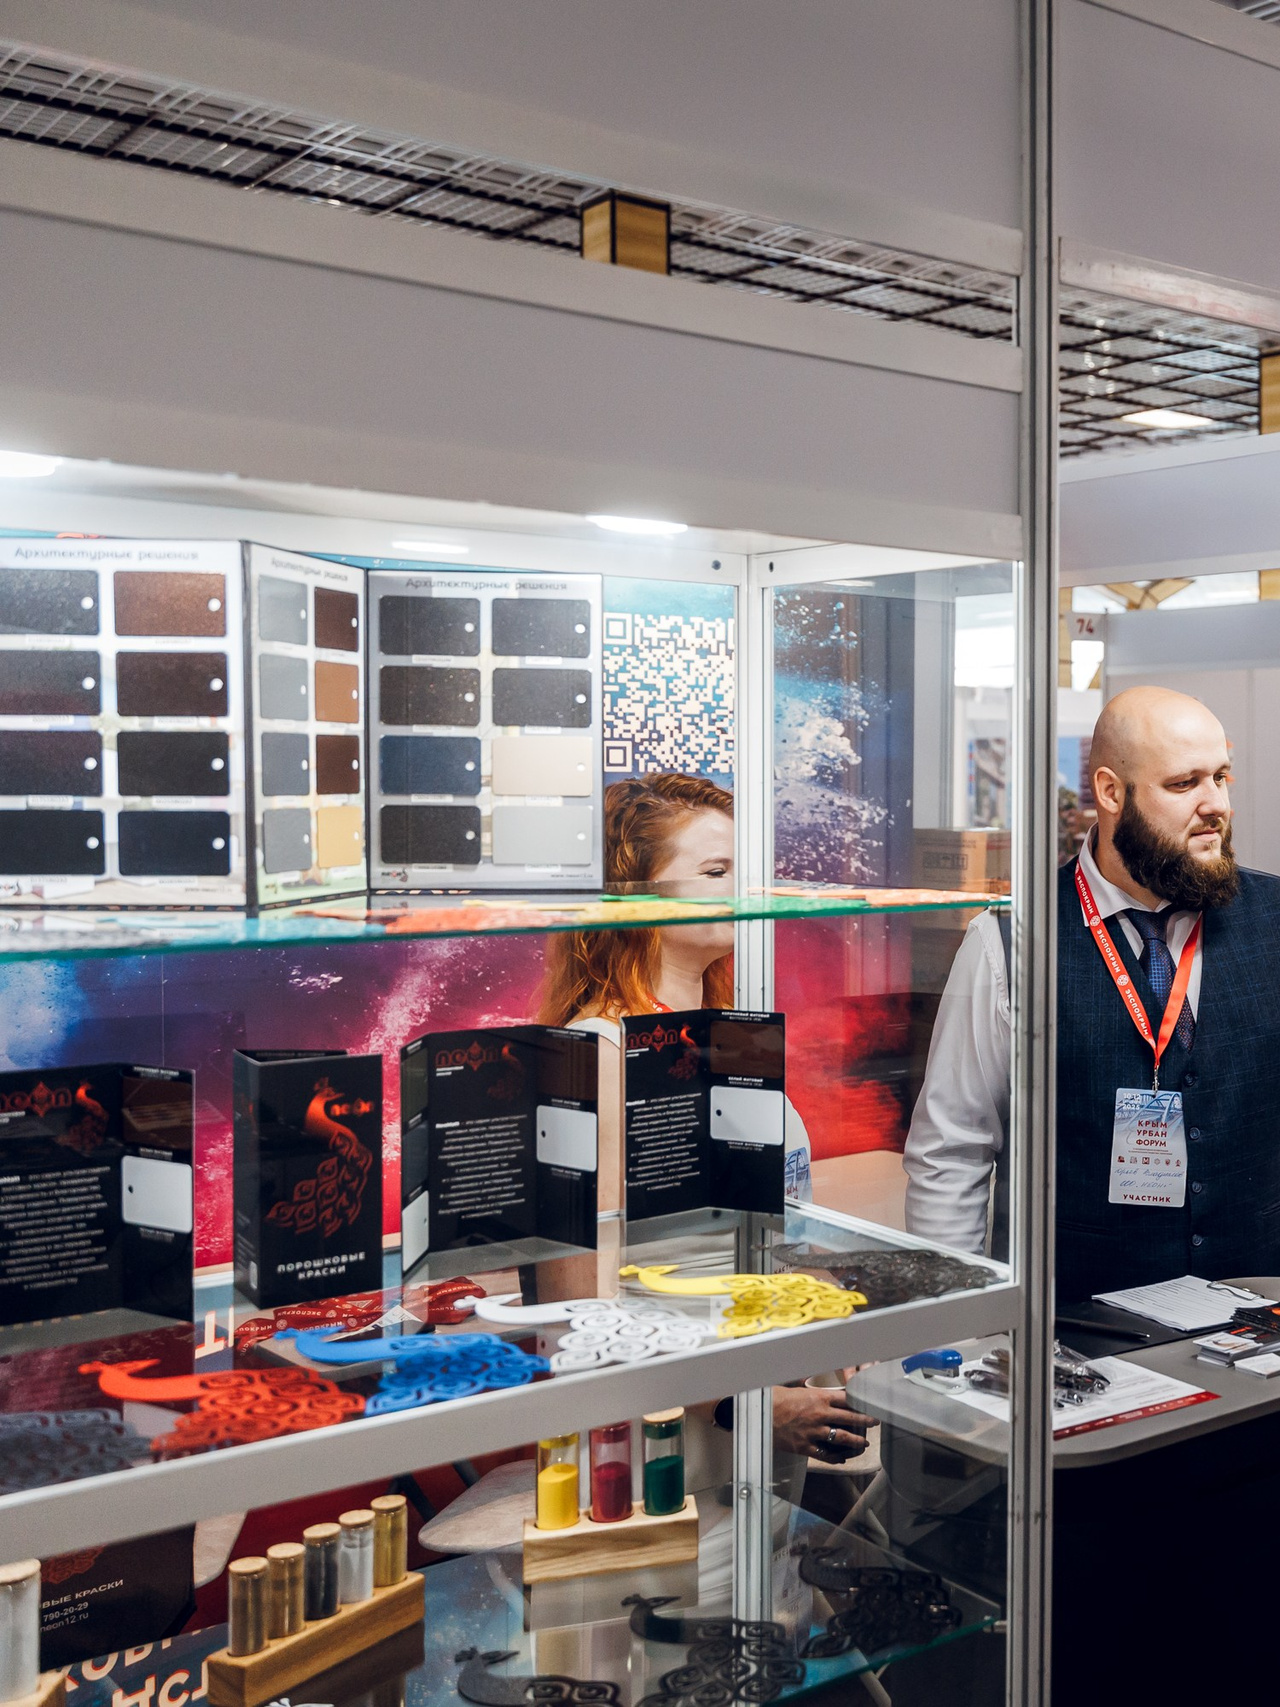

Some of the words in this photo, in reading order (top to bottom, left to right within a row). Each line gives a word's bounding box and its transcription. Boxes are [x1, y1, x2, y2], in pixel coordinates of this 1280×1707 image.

[1076, 618, 1094, 634] 74
[1076, 875, 1094, 914] ЭКСПОКРЫМ
[1096, 928, 1121, 973] ЭКСПОКРЫМ
[1124, 988, 1149, 1036] ЭКСПОКРЫМ
[1136, 1129, 1168, 1138] УРБАН
[1137, 1120, 1168, 1129] КРЫМ
[1135, 1138, 1167, 1148] ФОРУМ
[1123, 1193, 1171, 1203] УЧАСТНИК
[276, 1251, 366, 1274] ПОРОШКОВЫЕ
[298, 1264, 347, 1281] КРАСКИ
[40, 1594, 72, 1610] ВЫЕ
[75, 1578, 125, 1600] КРАСКИ
[43, 1602, 89, 1623] 790-20-29
